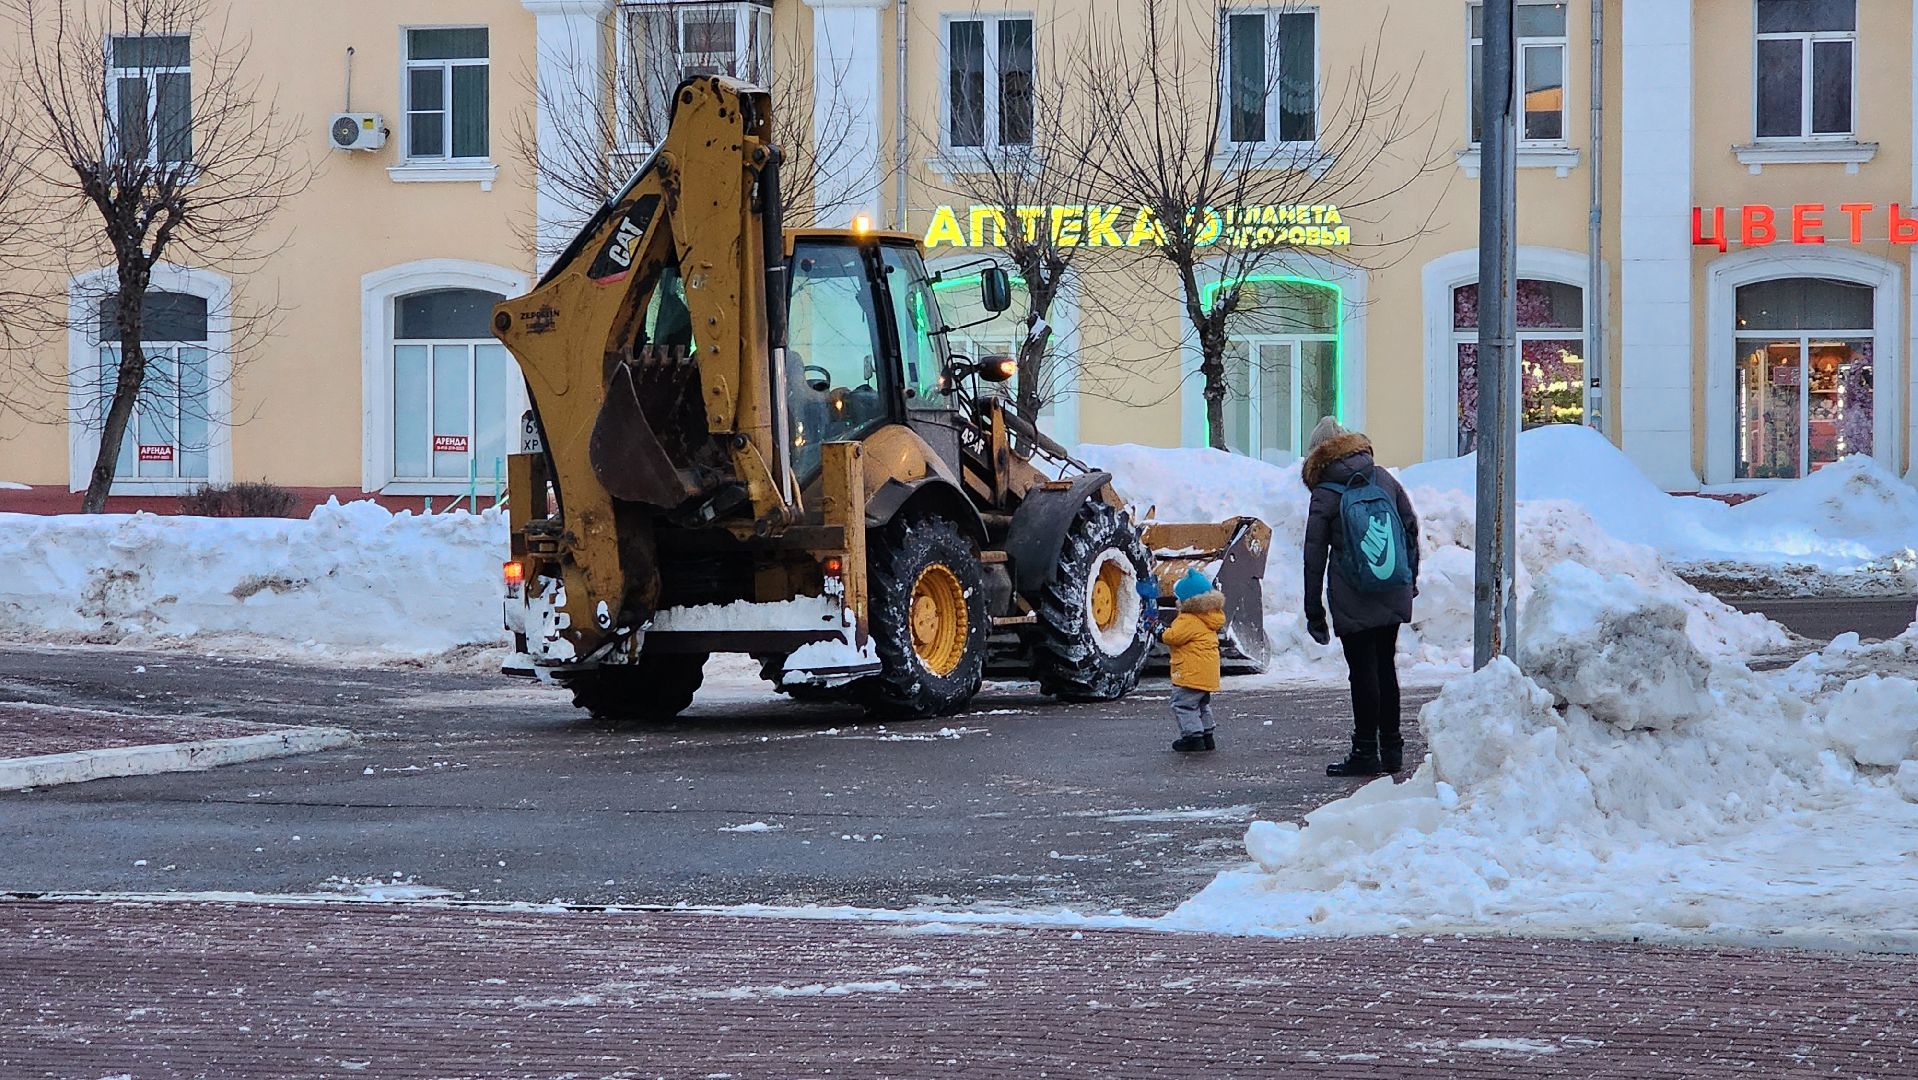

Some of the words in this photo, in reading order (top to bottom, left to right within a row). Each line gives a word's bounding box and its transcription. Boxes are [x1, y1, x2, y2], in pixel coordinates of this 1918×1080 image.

[923, 205, 1170, 248] АПТЕКА
[1226, 204, 1342, 225] ПЛАНЕТА
[609, 216, 644, 267] CAT
[140, 446, 171, 455] АРЕНДА
[435, 437, 467, 446] АРЕНДА
[1360, 513, 1389, 565] NIKE
